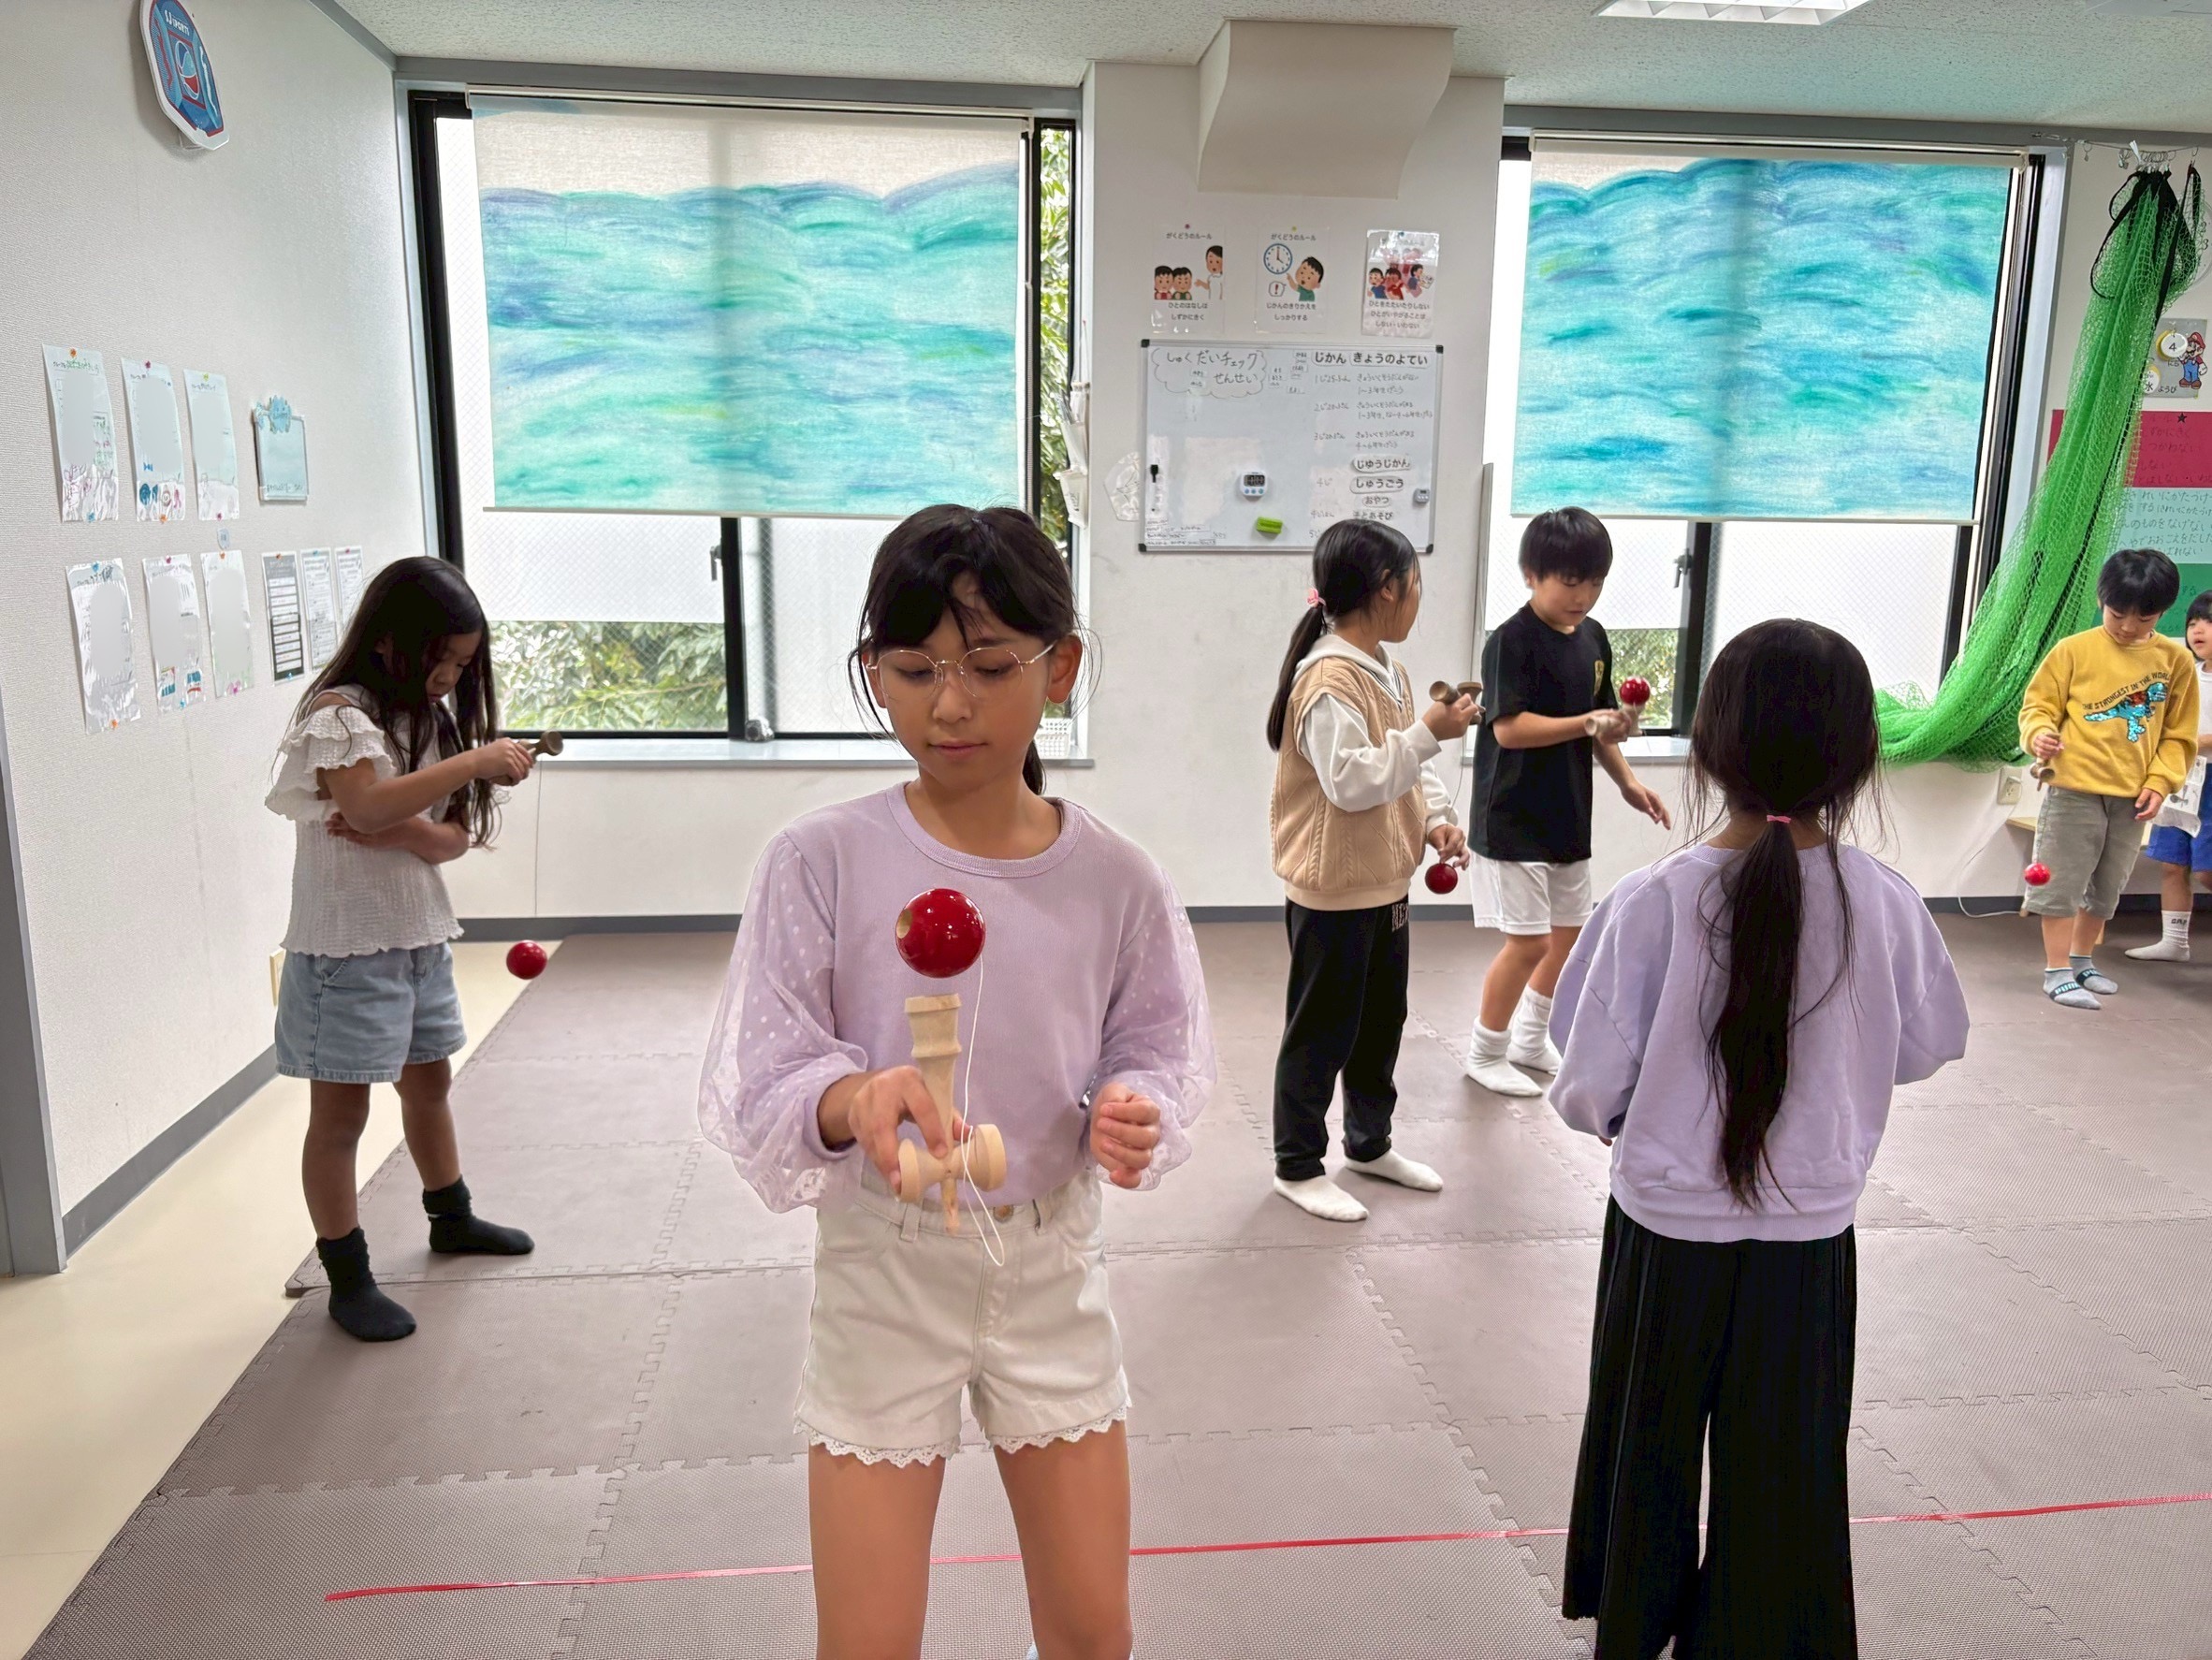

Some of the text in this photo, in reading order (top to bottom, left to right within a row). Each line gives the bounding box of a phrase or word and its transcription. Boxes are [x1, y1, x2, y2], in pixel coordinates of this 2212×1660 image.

[2203, 238, 2209, 250] 3
[2168, 342, 2177, 352] 4
[1166, 349, 1259, 371] しゅくだいチェック
[1315, 351, 1346, 364] じかん
[1353, 352, 1429, 366] きょうのよてい
[1213, 372, 1259, 385] せんせい
[2145, 381, 2153, 391] 水
[2158, 385, 2177, 393] ようび
[1356, 458, 1411, 470] じゆうじかん
[1356, 478, 1404, 488] しゅうごう
[1364, 495, 1390, 505] おやつ
[2094, 685, 2131, 709] STRONGEST
[2130, 683, 2139, 692] IN
[2139, 675, 2152, 687] THE
[2151, 672, 2170, 680] WORL
